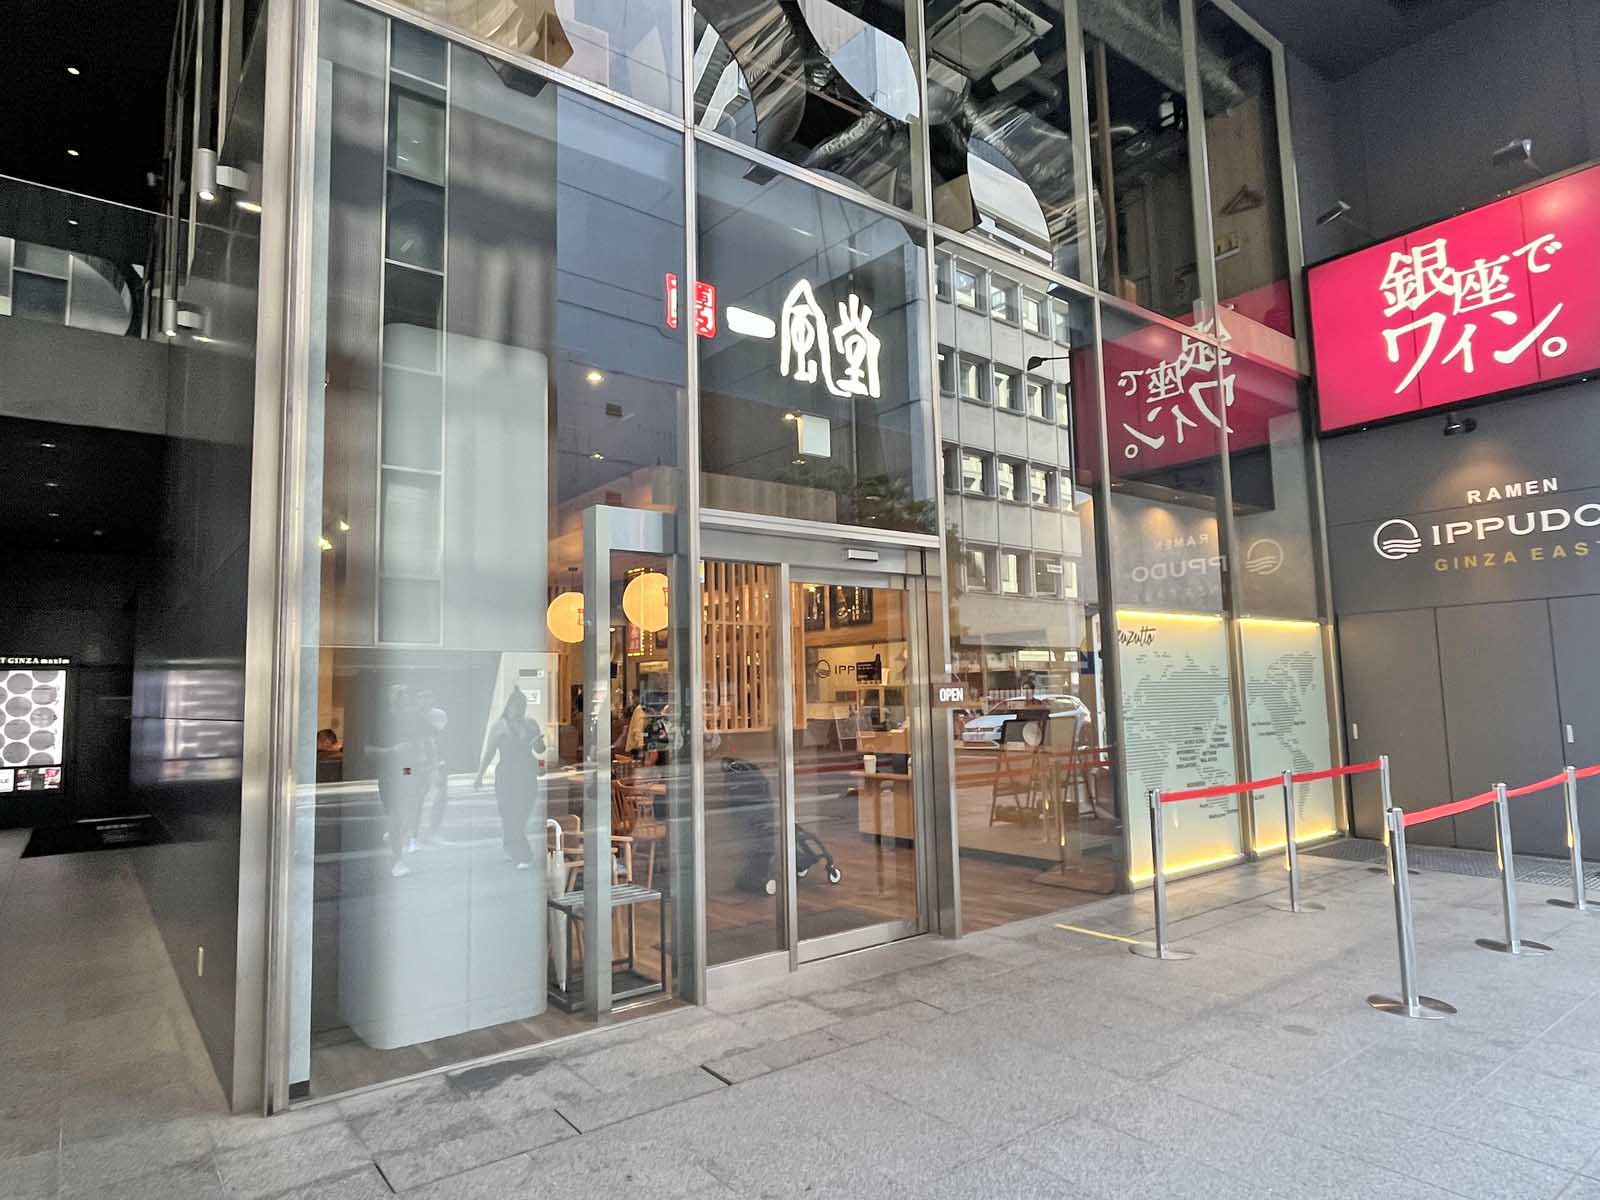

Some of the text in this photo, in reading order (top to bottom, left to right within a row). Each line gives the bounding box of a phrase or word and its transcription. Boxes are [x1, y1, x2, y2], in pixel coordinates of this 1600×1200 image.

[1379, 233, 1563, 318] 銀座で
[726, 278, 881, 399] 一風堂
[1381, 302, 1568, 395] ワイン。
[1466, 477, 1559, 505] RAMEN
[1431, 503, 1600, 546] IPPUDO
[1434, 540, 1600, 572] GINZA EAS
[834, 665, 855, 675] IPP
[939, 687, 964, 702] OPEN
